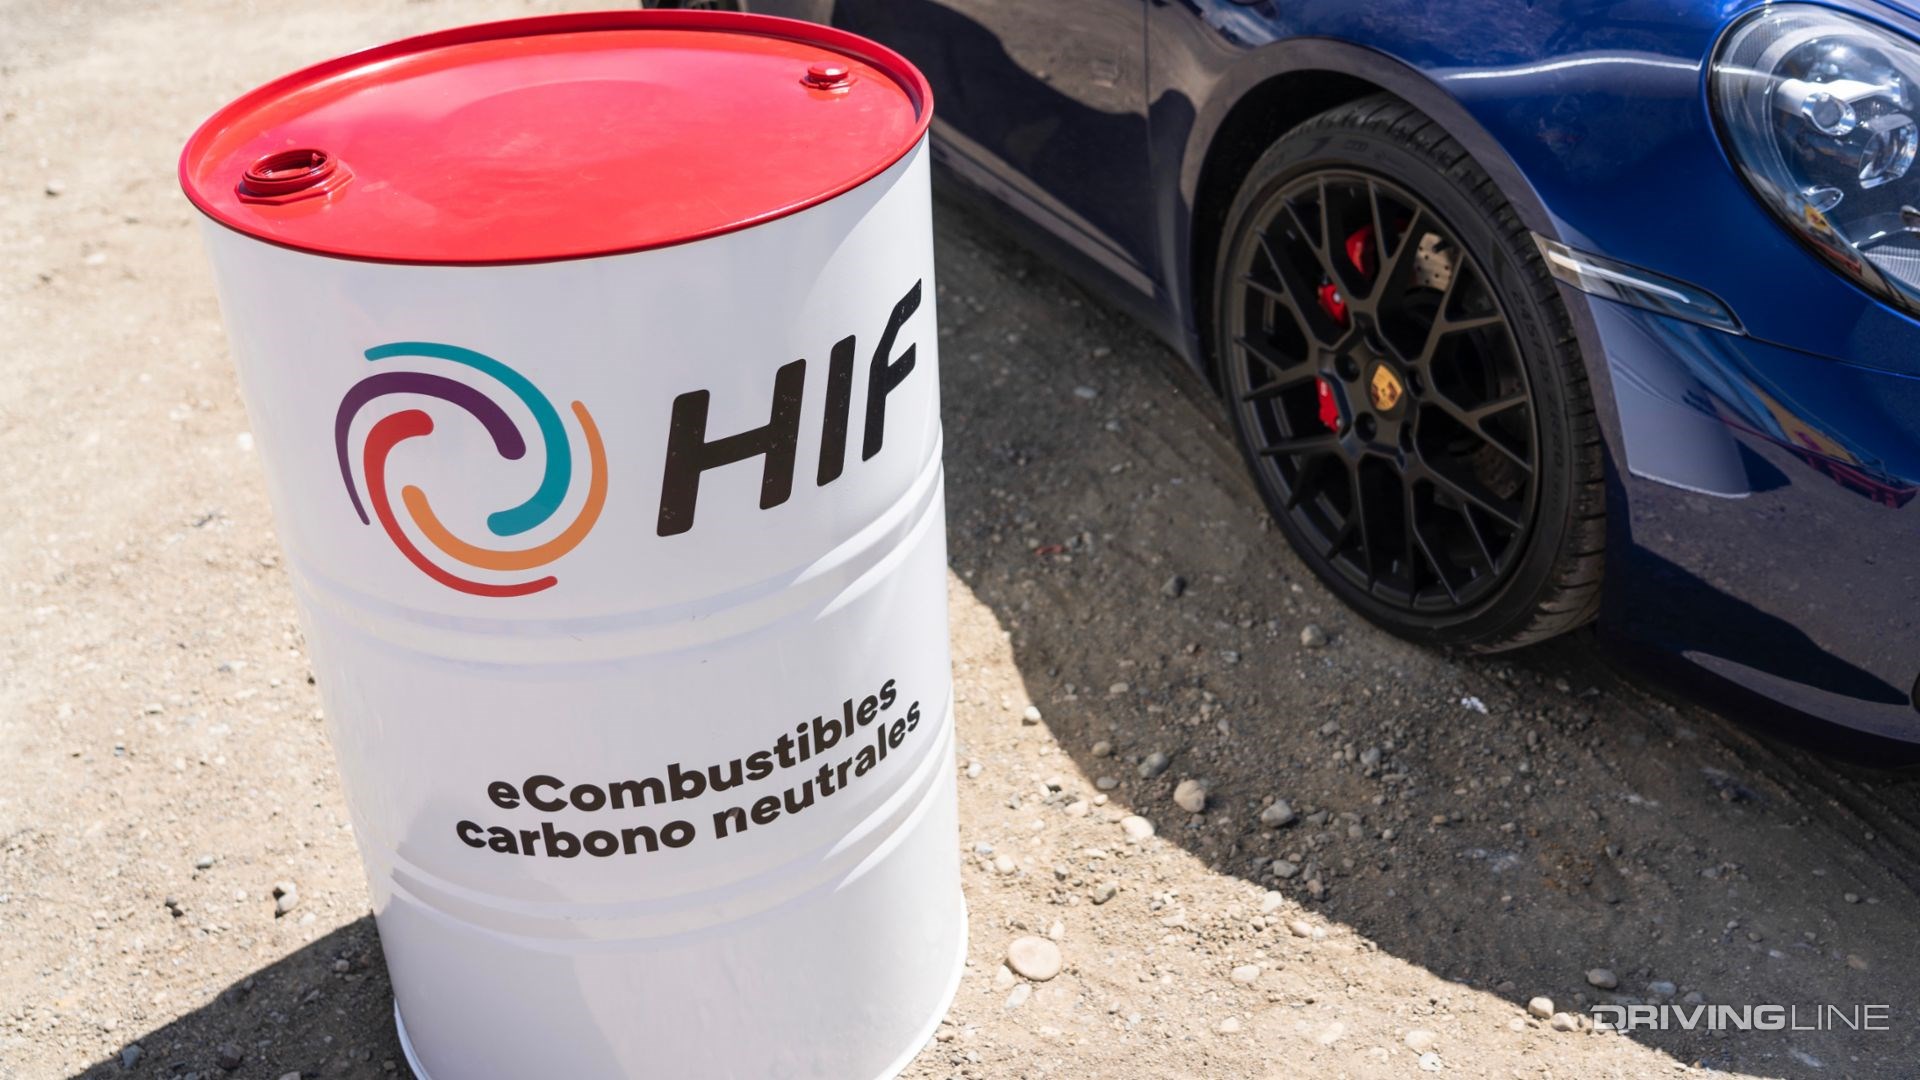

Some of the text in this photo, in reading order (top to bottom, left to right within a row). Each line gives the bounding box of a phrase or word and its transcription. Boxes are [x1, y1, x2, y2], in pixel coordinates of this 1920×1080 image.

[657, 278, 921, 537] HIF
[456, 701, 921, 858] carbono neutrales
[488, 679, 897, 813] eCombustibles
